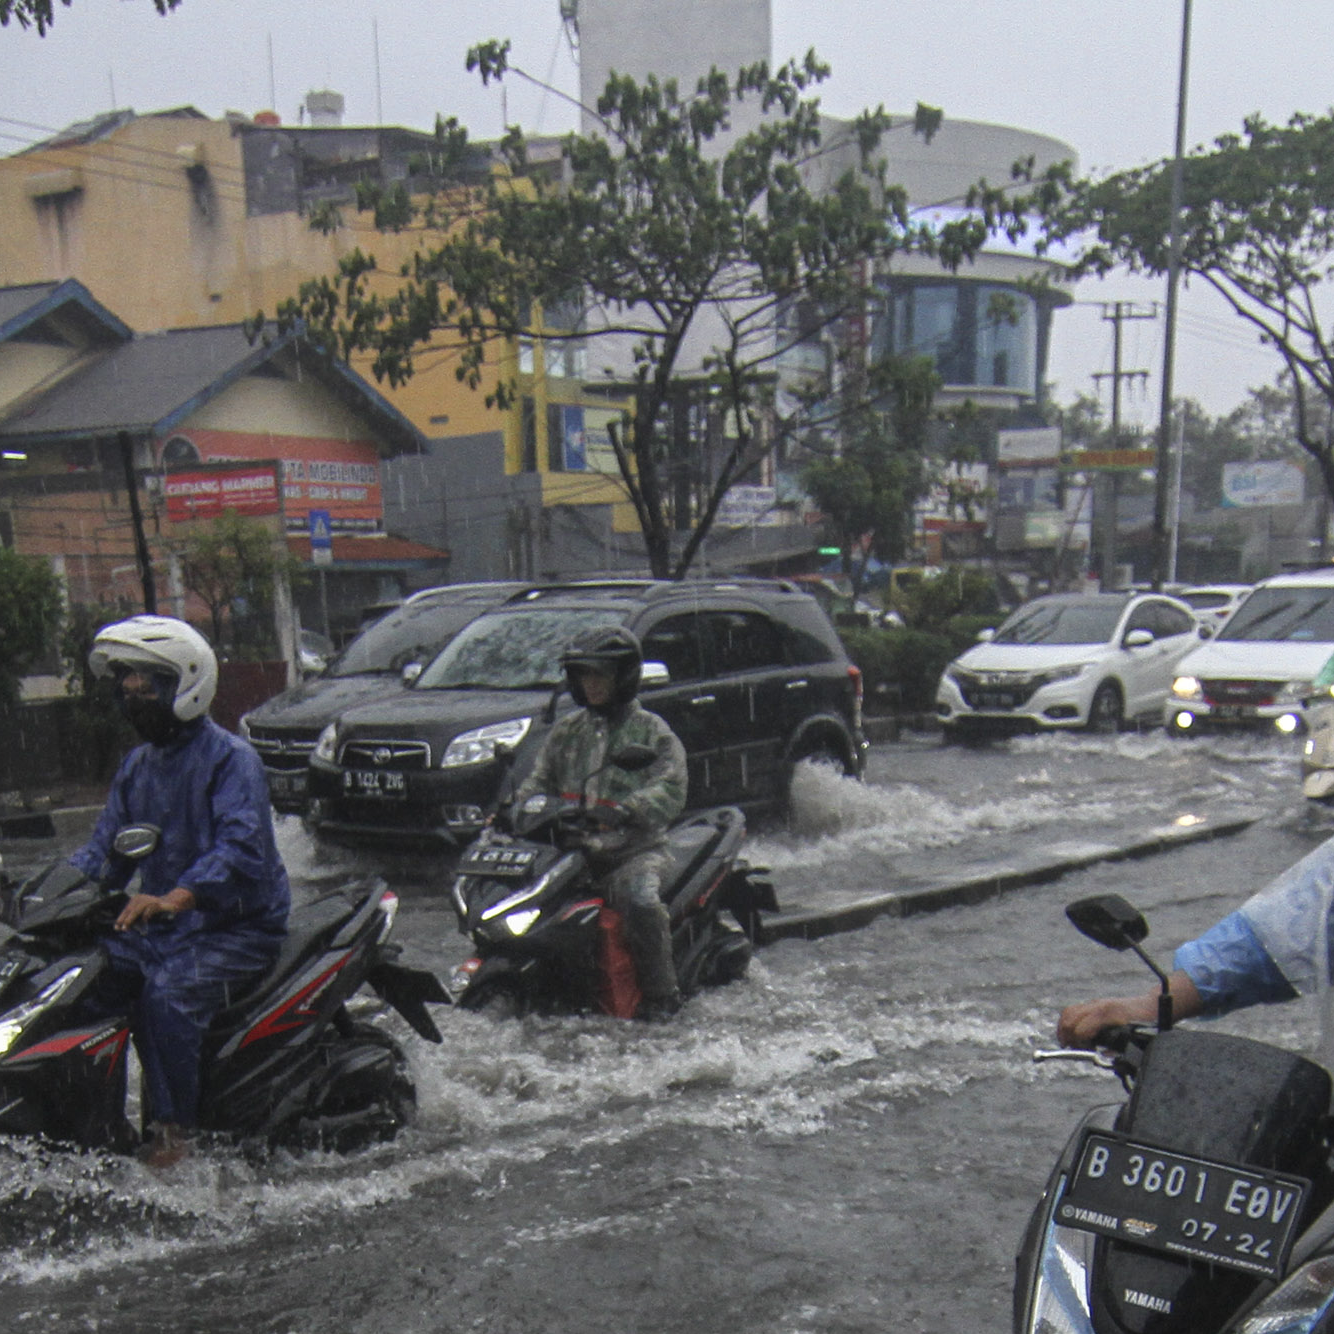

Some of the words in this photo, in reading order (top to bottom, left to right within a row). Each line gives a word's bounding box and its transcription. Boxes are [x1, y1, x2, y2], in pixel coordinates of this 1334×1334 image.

[1088, 1145, 1110, 1178] B
[1122, 1155, 1208, 1203] 3601
[1075, 1207, 1118, 1230] YAMAHA
[1124, 1287, 1172, 1314] YAMAHA
